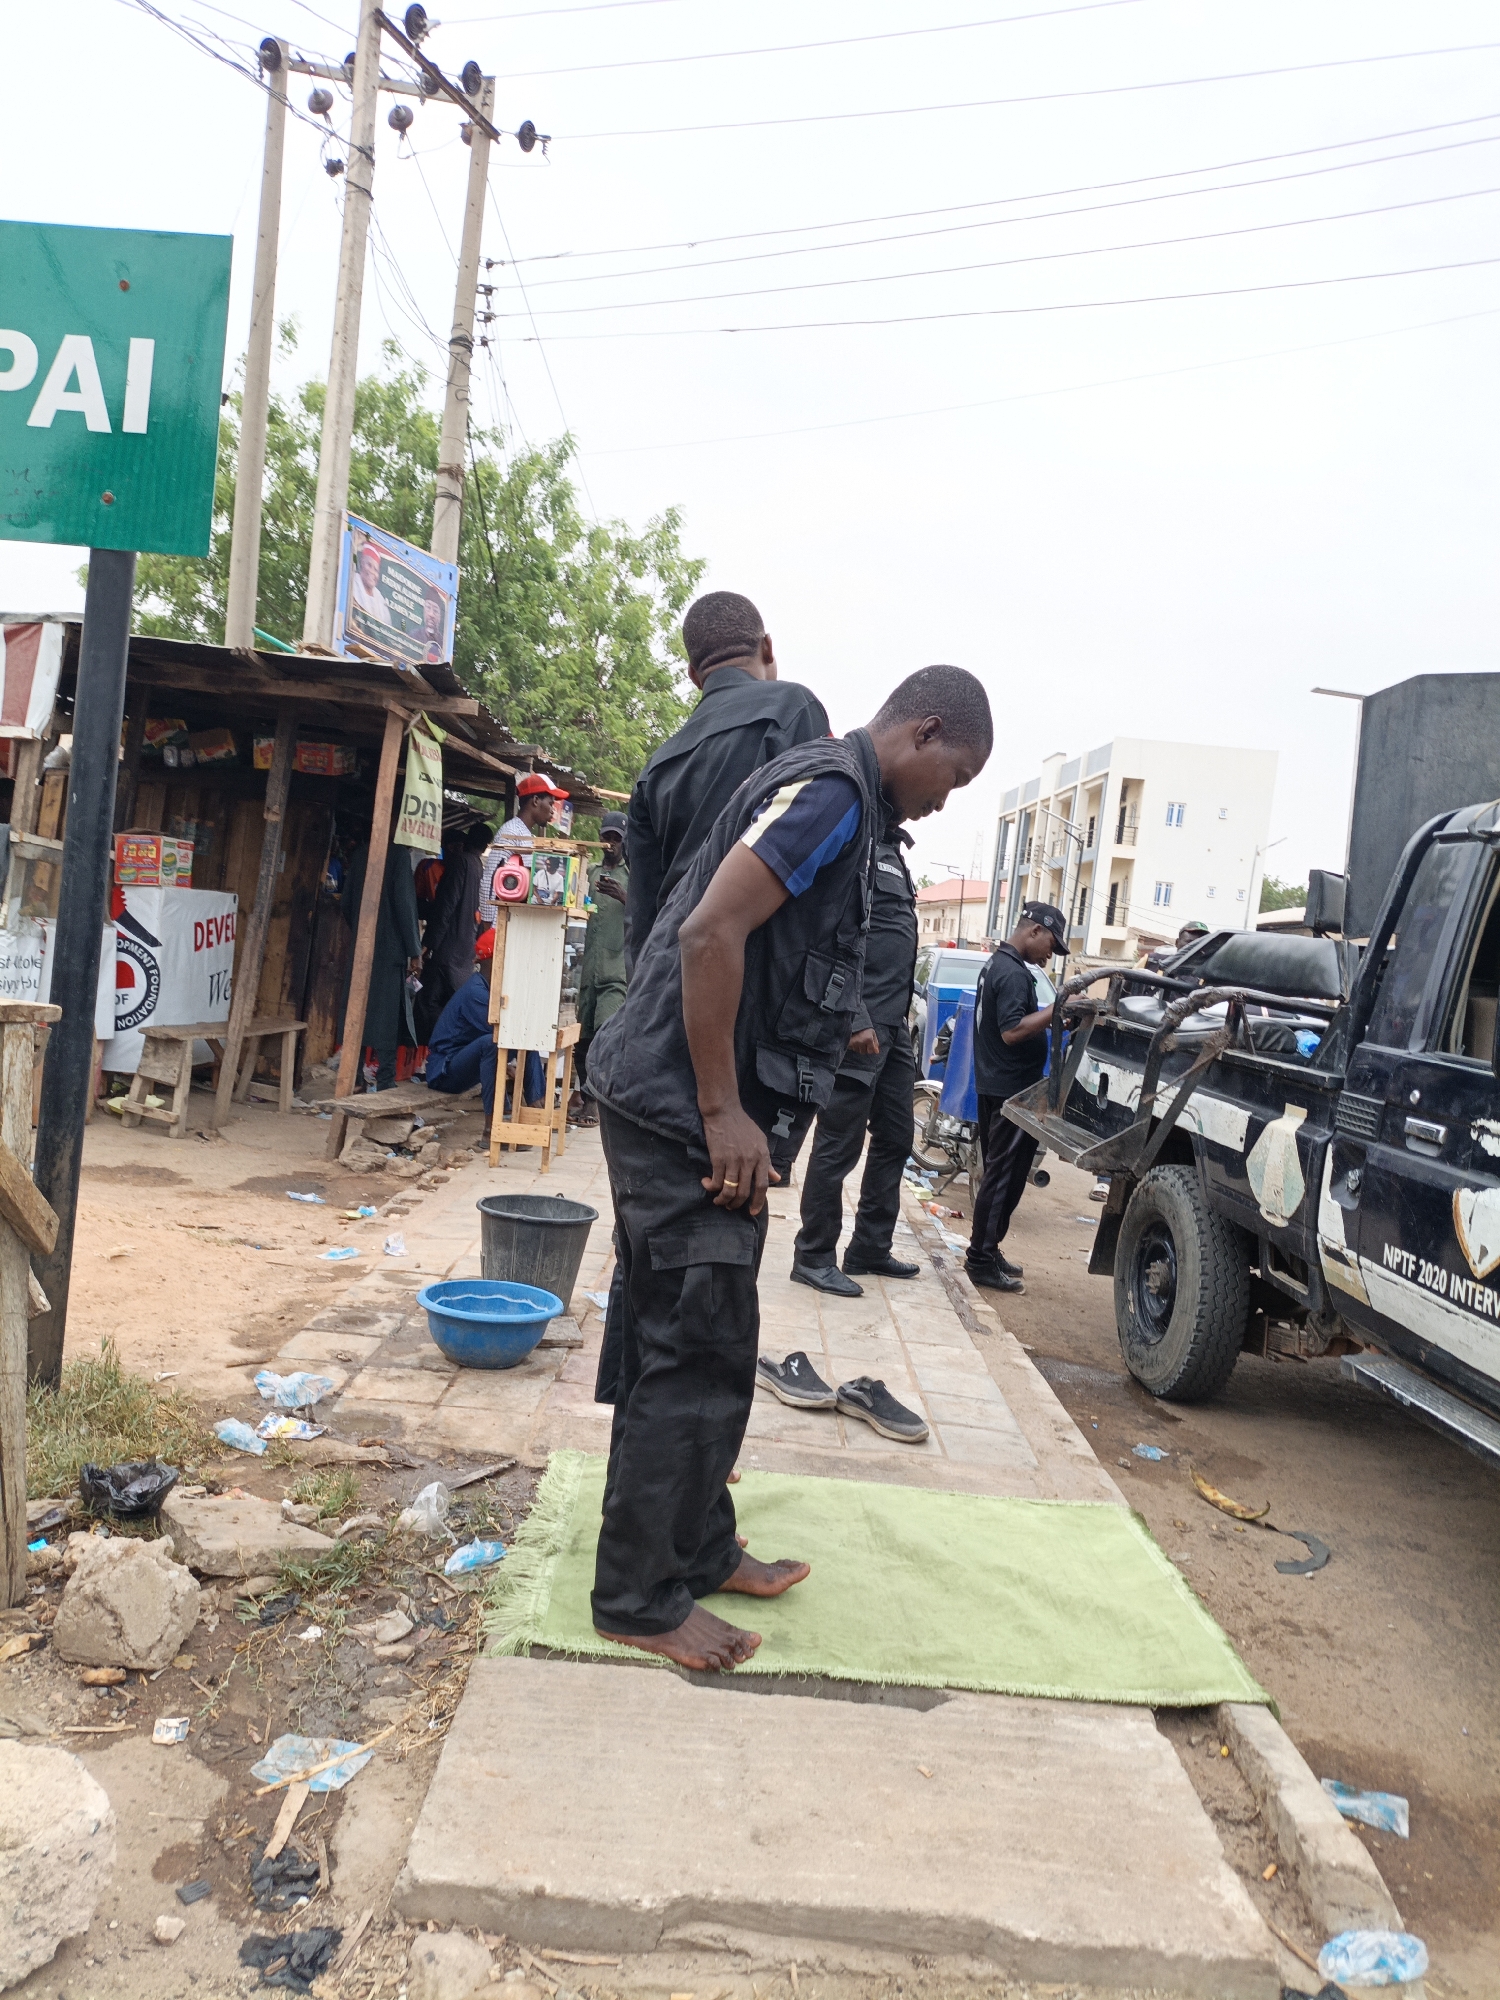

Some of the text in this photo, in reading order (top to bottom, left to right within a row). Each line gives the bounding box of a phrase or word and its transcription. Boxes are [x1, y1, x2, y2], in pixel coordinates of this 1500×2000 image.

[0, 328, 155, 434] PAI
[117, 968, 160, 1029] FOUNDATION
[1383, 1243, 1417, 1278] NPTF
[1418, 1259, 1448, 1294] 2020
